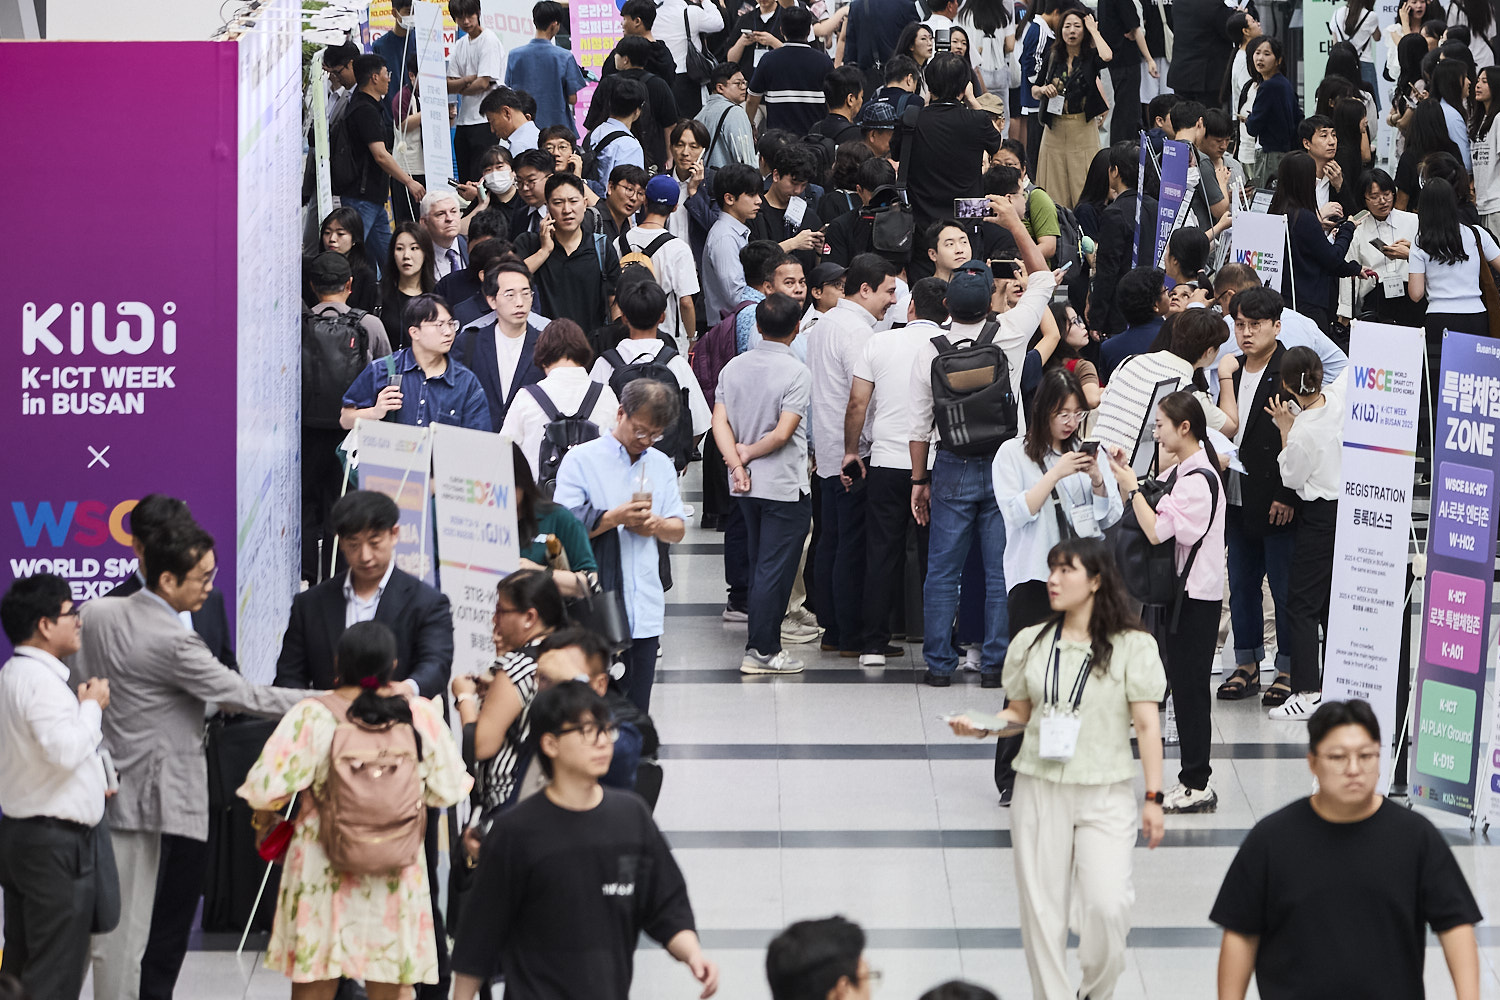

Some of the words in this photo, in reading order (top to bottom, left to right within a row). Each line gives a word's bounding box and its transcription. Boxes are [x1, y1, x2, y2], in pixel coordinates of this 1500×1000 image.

[1236, 249, 1263, 271] WSCE
[22, 366, 97, 389] K-ICT
[101, 366, 177, 389] WEEK
[1354, 366, 1393, 392] WSCE
[22, 392, 46, 415] in
[52, 392, 145, 415] BUSAN
[1444, 417, 1496, 456] ZONE
[1345, 481, 1406, 504] REGISTRATION
[11, 499, 139, 548] WSC
[1353, 508, 1393, 531] 등록데스크
[1465, 503, 1490, 528] 엔터존
[1448, 532, 1475, 551] W-H02
[10, 558, 100, 579] WORLD
[1447, 588, 1467, 605] K-ICT
[1429, 607, 1445, 627] 로봇
[1445, 610, 1481, 636] 특별체험존
[1441, 641, 1465, 661] K-A01
[1439, 698, 1459, 715] K-ICT
[1420, 717, 1428, 732] AI
[1428, 718, 1447, 739] PLAY
[1447, 724, 1472, 745] Ground
[1432, 751, 1456, 770] K-D15
